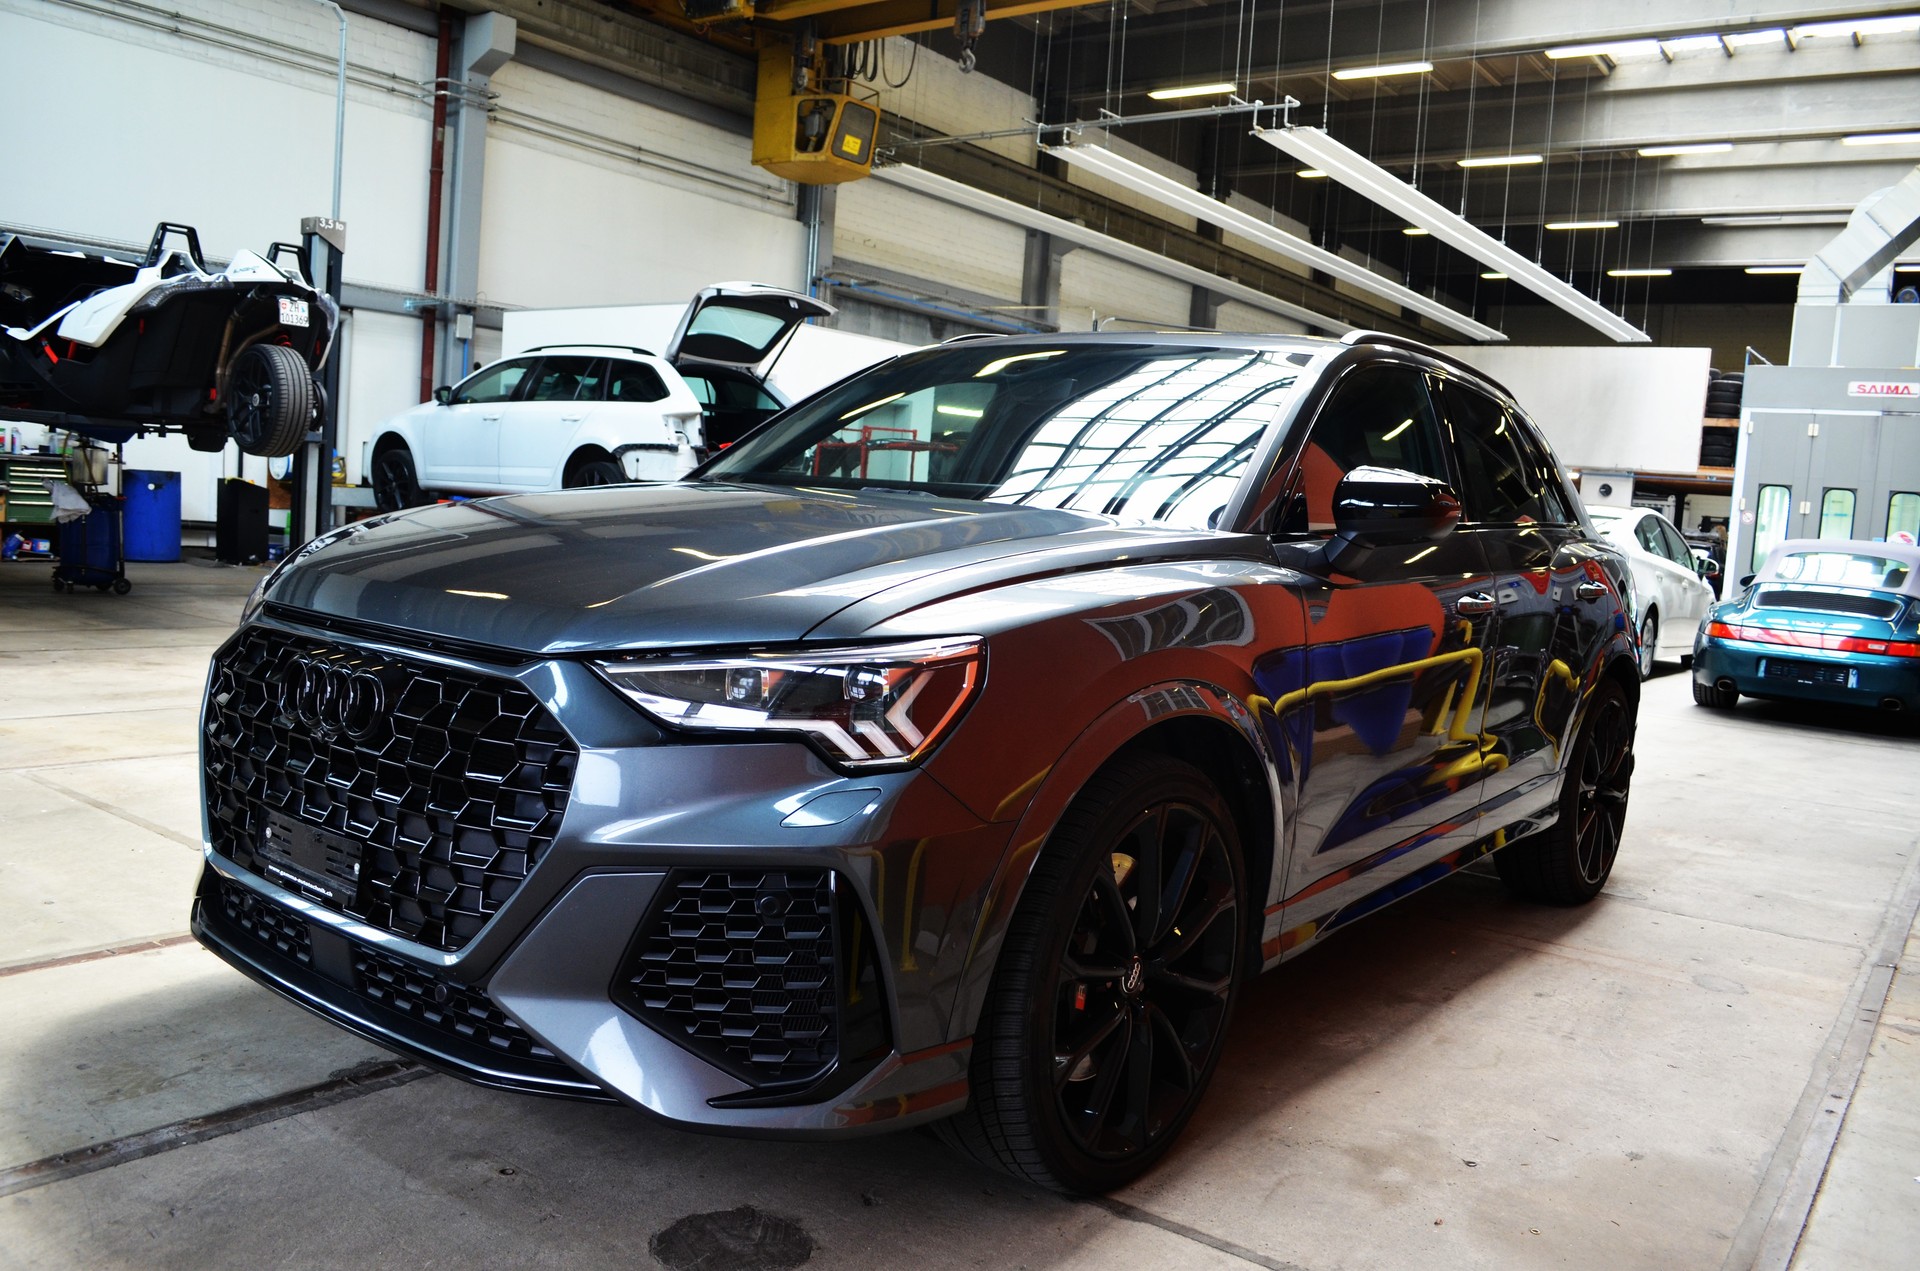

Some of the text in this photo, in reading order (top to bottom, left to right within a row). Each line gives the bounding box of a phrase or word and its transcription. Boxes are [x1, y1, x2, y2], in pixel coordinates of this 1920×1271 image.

[319, 217, 334, 229] 3,5
[289, 301, 300, 313] ZH
[281, 312, 309, 326] 101369
[1856, 384, 1911, 395] SAIMA
